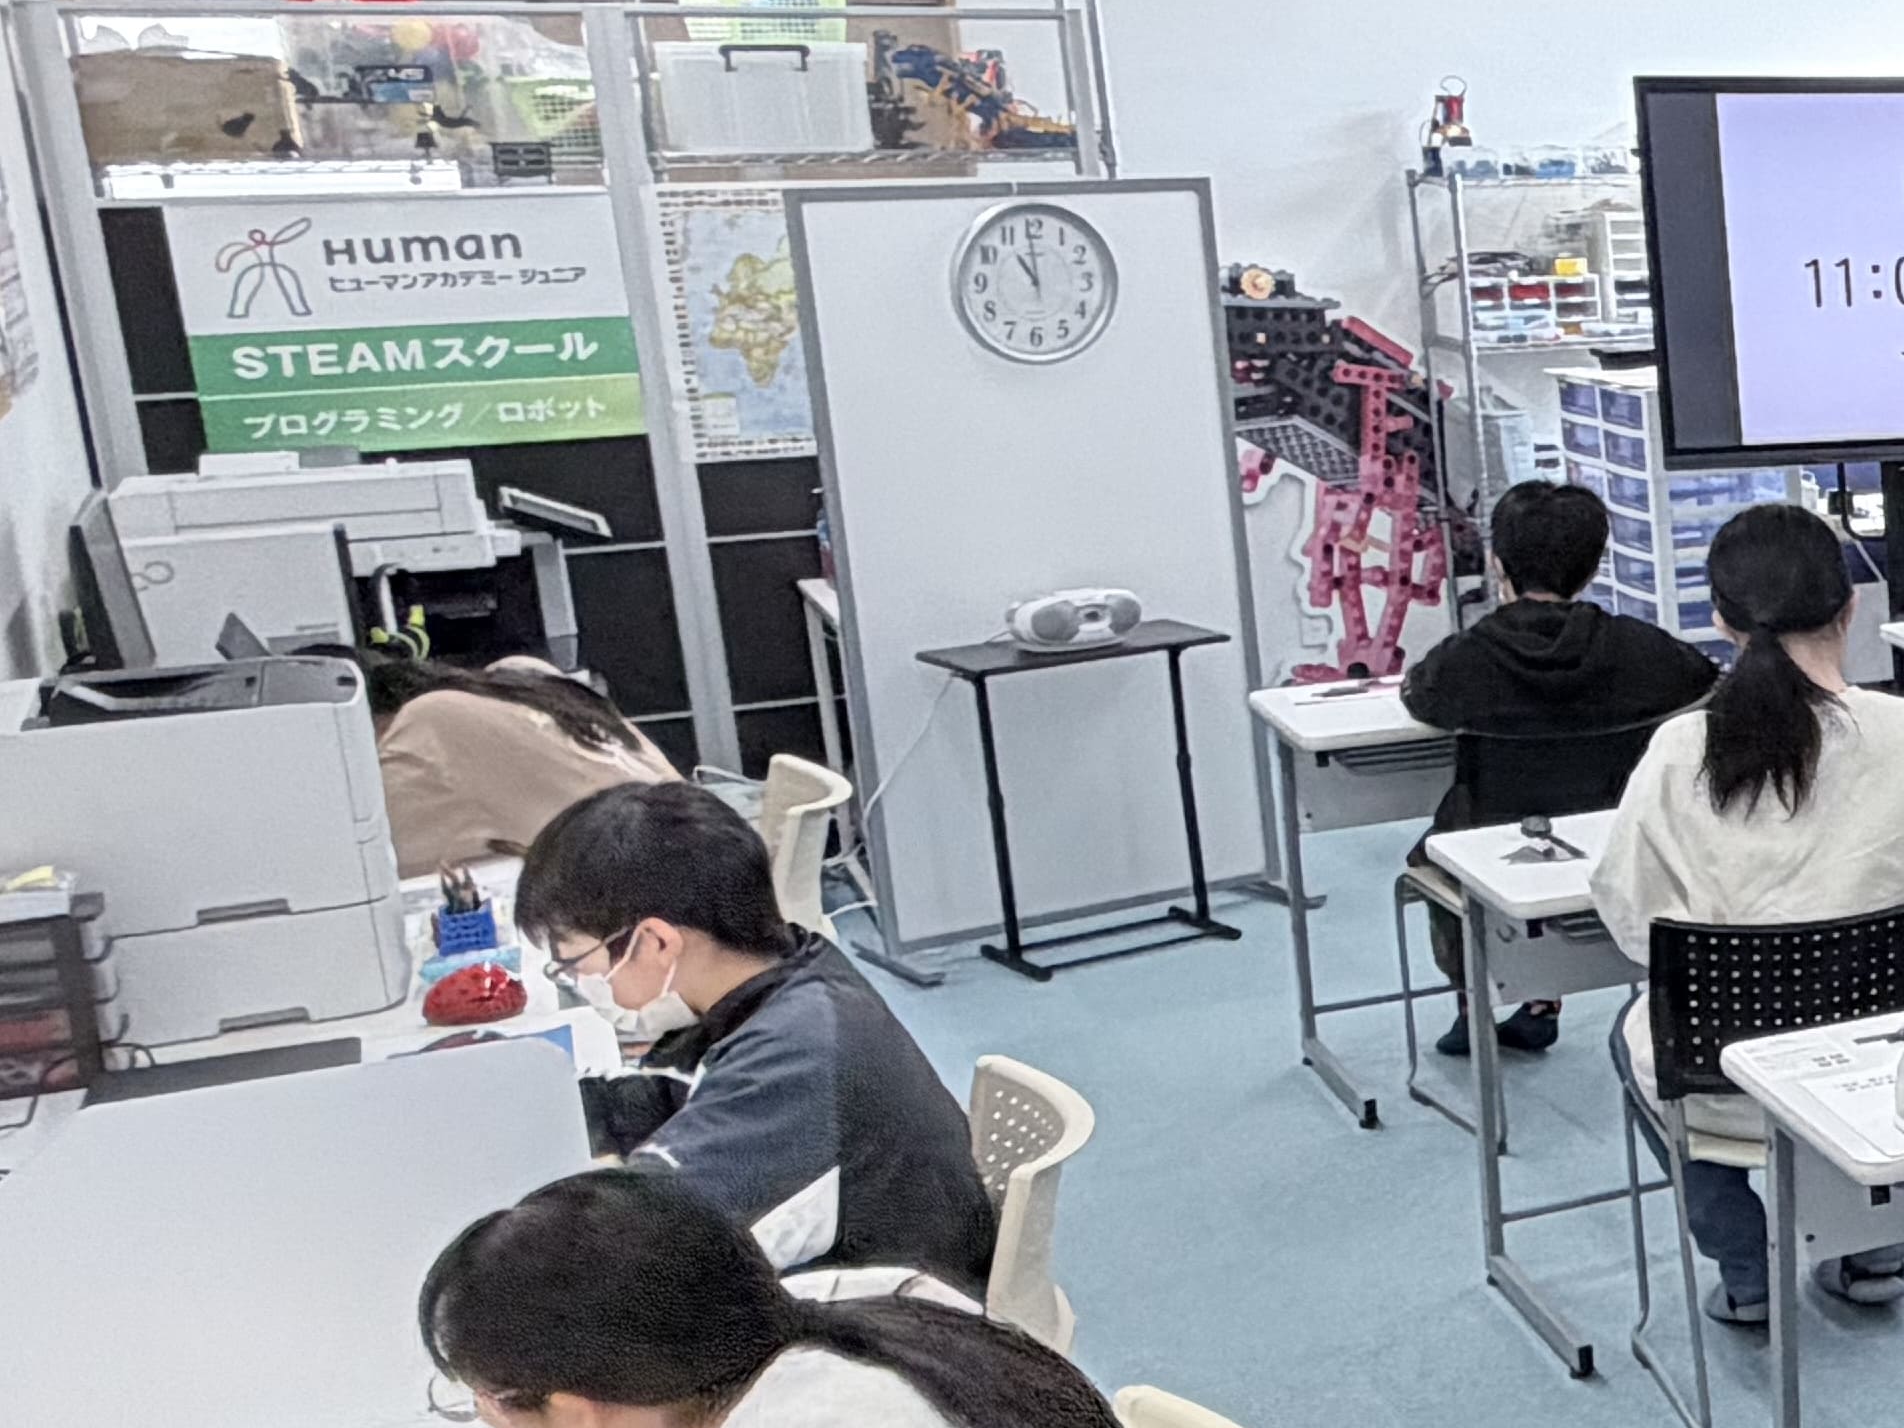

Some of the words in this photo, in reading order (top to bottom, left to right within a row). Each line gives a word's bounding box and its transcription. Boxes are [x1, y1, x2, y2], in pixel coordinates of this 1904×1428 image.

[1000, 225, 1014, 245] 11
[1025, 218, 1043, 239] 12
[1058, 226, 1065, 246] 1
[322, 232, 522, 266] Human
[980, 245, 997, 265] 10
[1073, 245, 1087, 265] 2
[329, 270, 513, 292] ヒューマンアカデミー
[519, 266, 586, 284] ジュニア
[974, 272, 988, 294] 9
[1079, 272, 1093, 292] 3
[983, 301, 996, 322] 8
[1075, 300, 1086, 319] 4
[1003, 321, 1016, 340] 7
[1030, 326, 1043, 347] 6
[1057, 319, 1069, 339] 5
[232, 332, 599, 380] STEAMスクール
